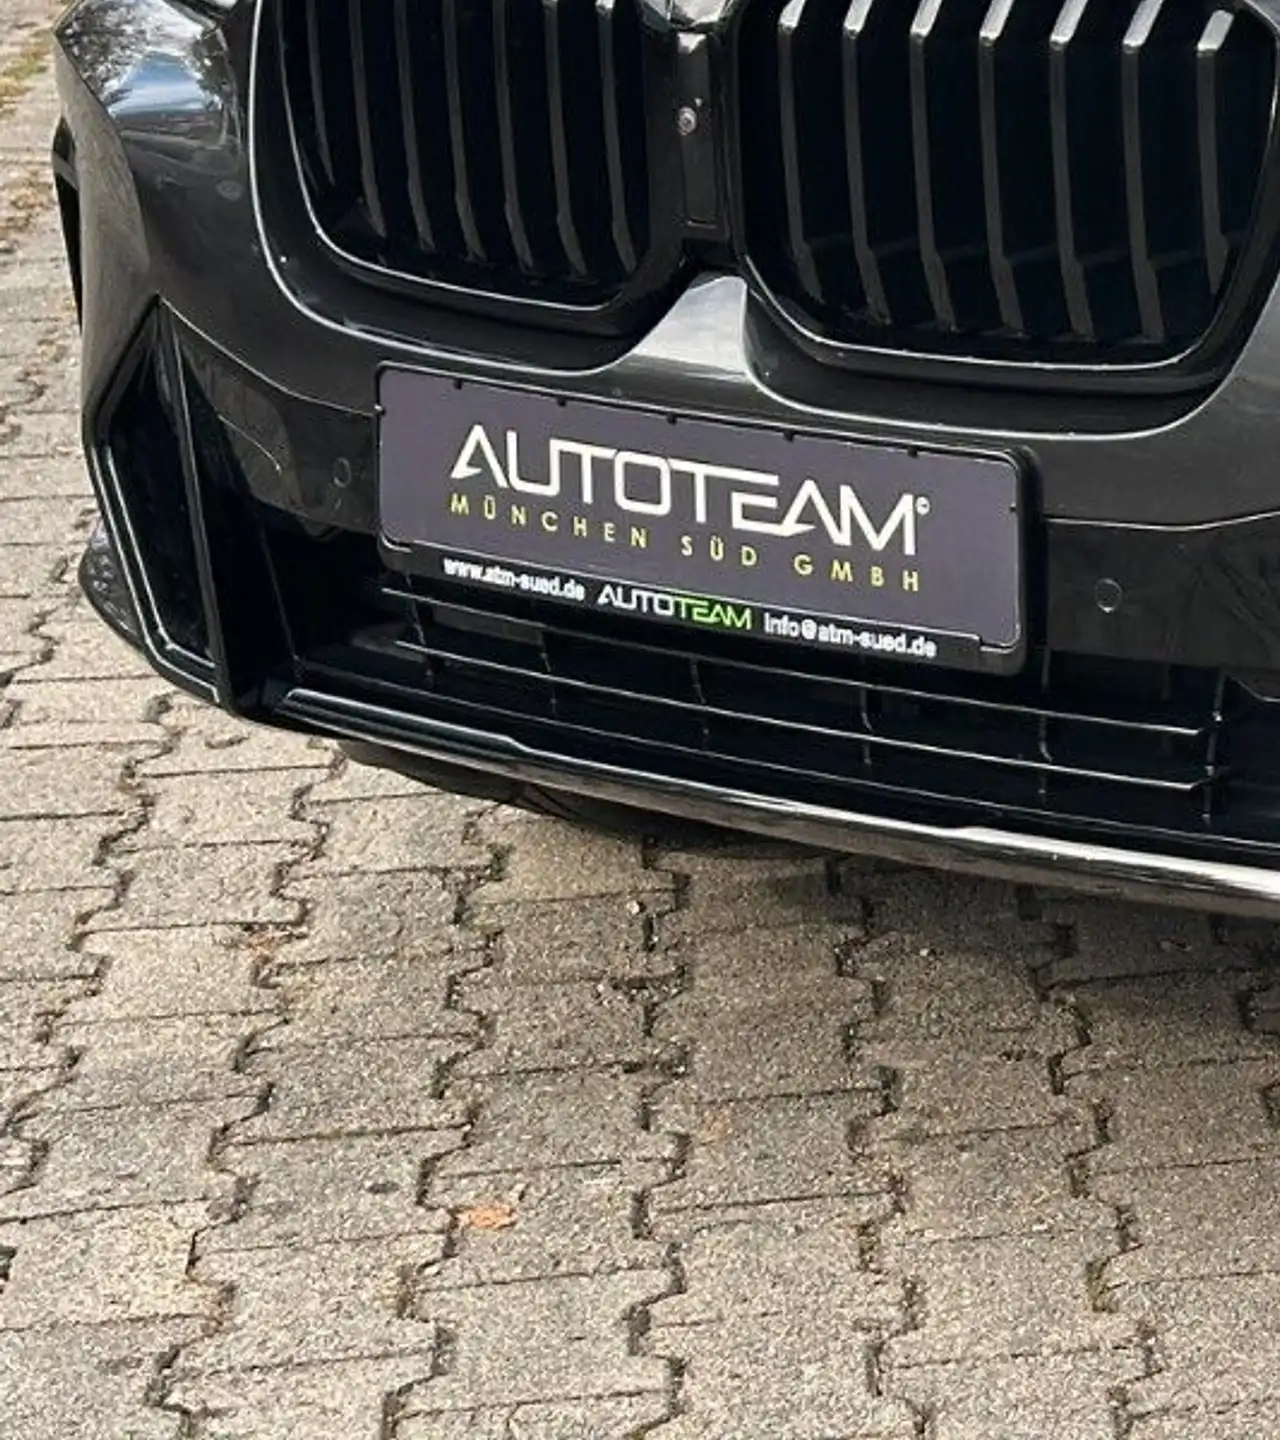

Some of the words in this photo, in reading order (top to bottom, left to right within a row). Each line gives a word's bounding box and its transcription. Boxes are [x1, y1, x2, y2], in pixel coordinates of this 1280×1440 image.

[450, 424, 917, 556] AUTOTEAM
[450, 492, 648, 549] MÜNCHEN
[680, 535, 758, 567] SÜD
[793, 553, 920, 592] GMBH
[443, 557, 586, 602] www.atm-sued.de
[596, 583, 753, 631] AUTOTEAM
